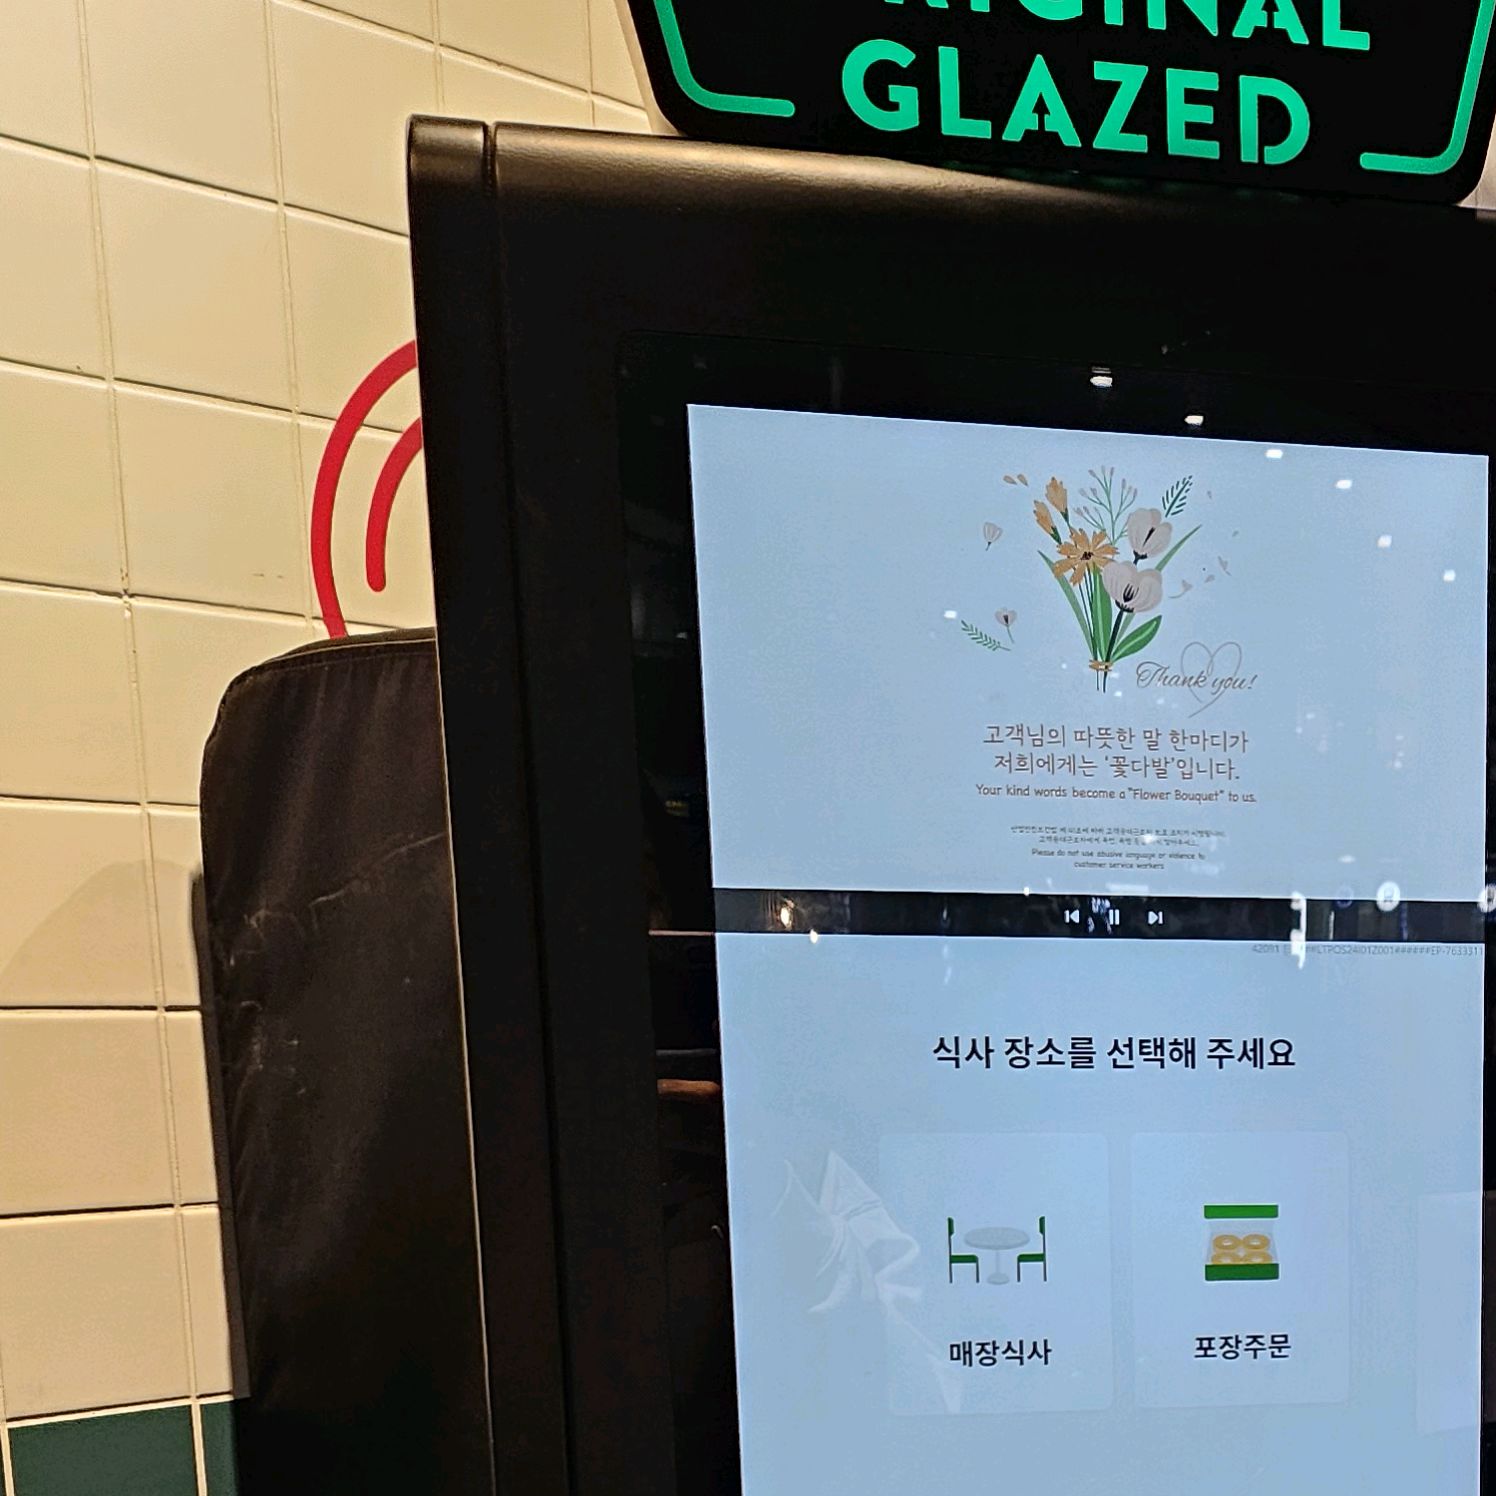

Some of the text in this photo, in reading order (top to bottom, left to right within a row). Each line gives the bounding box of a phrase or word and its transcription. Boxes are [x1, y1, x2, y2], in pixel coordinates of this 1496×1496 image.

[842, 38, 1311, 165] GLAZED
[1136, 661, 1208, 690] Thank
[983, 723, 1250, 753] 고객님의 따뜻한 말 한마디가
[994, 752, 1098, 778] 저희에게는
[976, 783, 1002, 797] Your
[1006, 784, 1030, 798] kind
[1034, 785, 1067, 798] words
[1072, 786, 1116, 800] become
[1119, 790, 1126, 800] a
[1228, 791, 1239, 803] to
[933, 1036, 1296, 1070] 식사 장소를 선택해 주세요
[948, 1339, 1052, 1366] 매장식사
[1195, 1333, 1291, 1360] 포장주문
